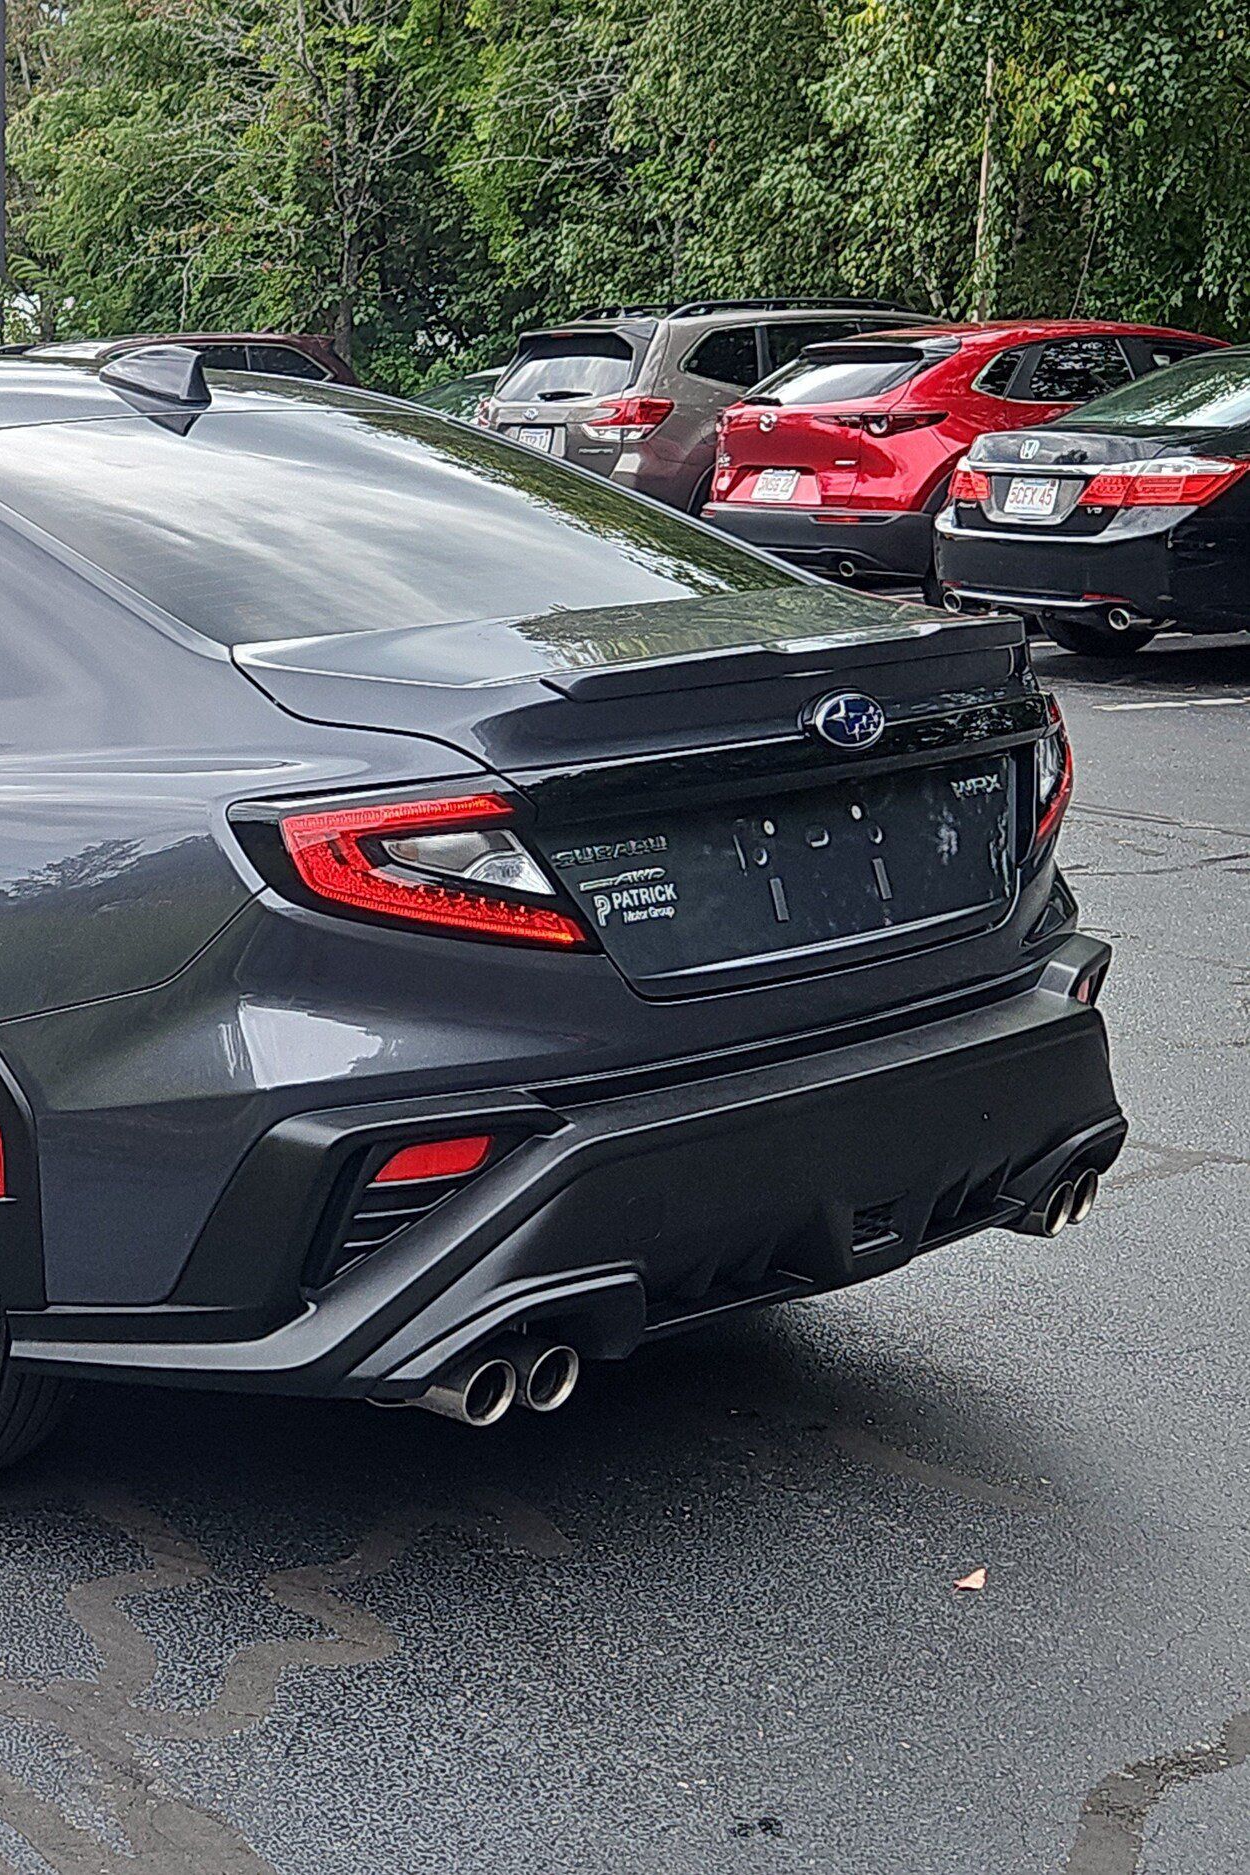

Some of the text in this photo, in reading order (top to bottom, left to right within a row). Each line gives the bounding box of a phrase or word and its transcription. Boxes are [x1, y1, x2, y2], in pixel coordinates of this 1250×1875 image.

[1008, 486, 1054, 506] 5CFX 45
[950, 774, 1003, 799] WRX
[551, 836, 668, 868] SUBARU
[614, 867, 666, 885] AWD
[611, 883, 678, 910] PATRICK
[622, 906, 676, 924] Motor Group
